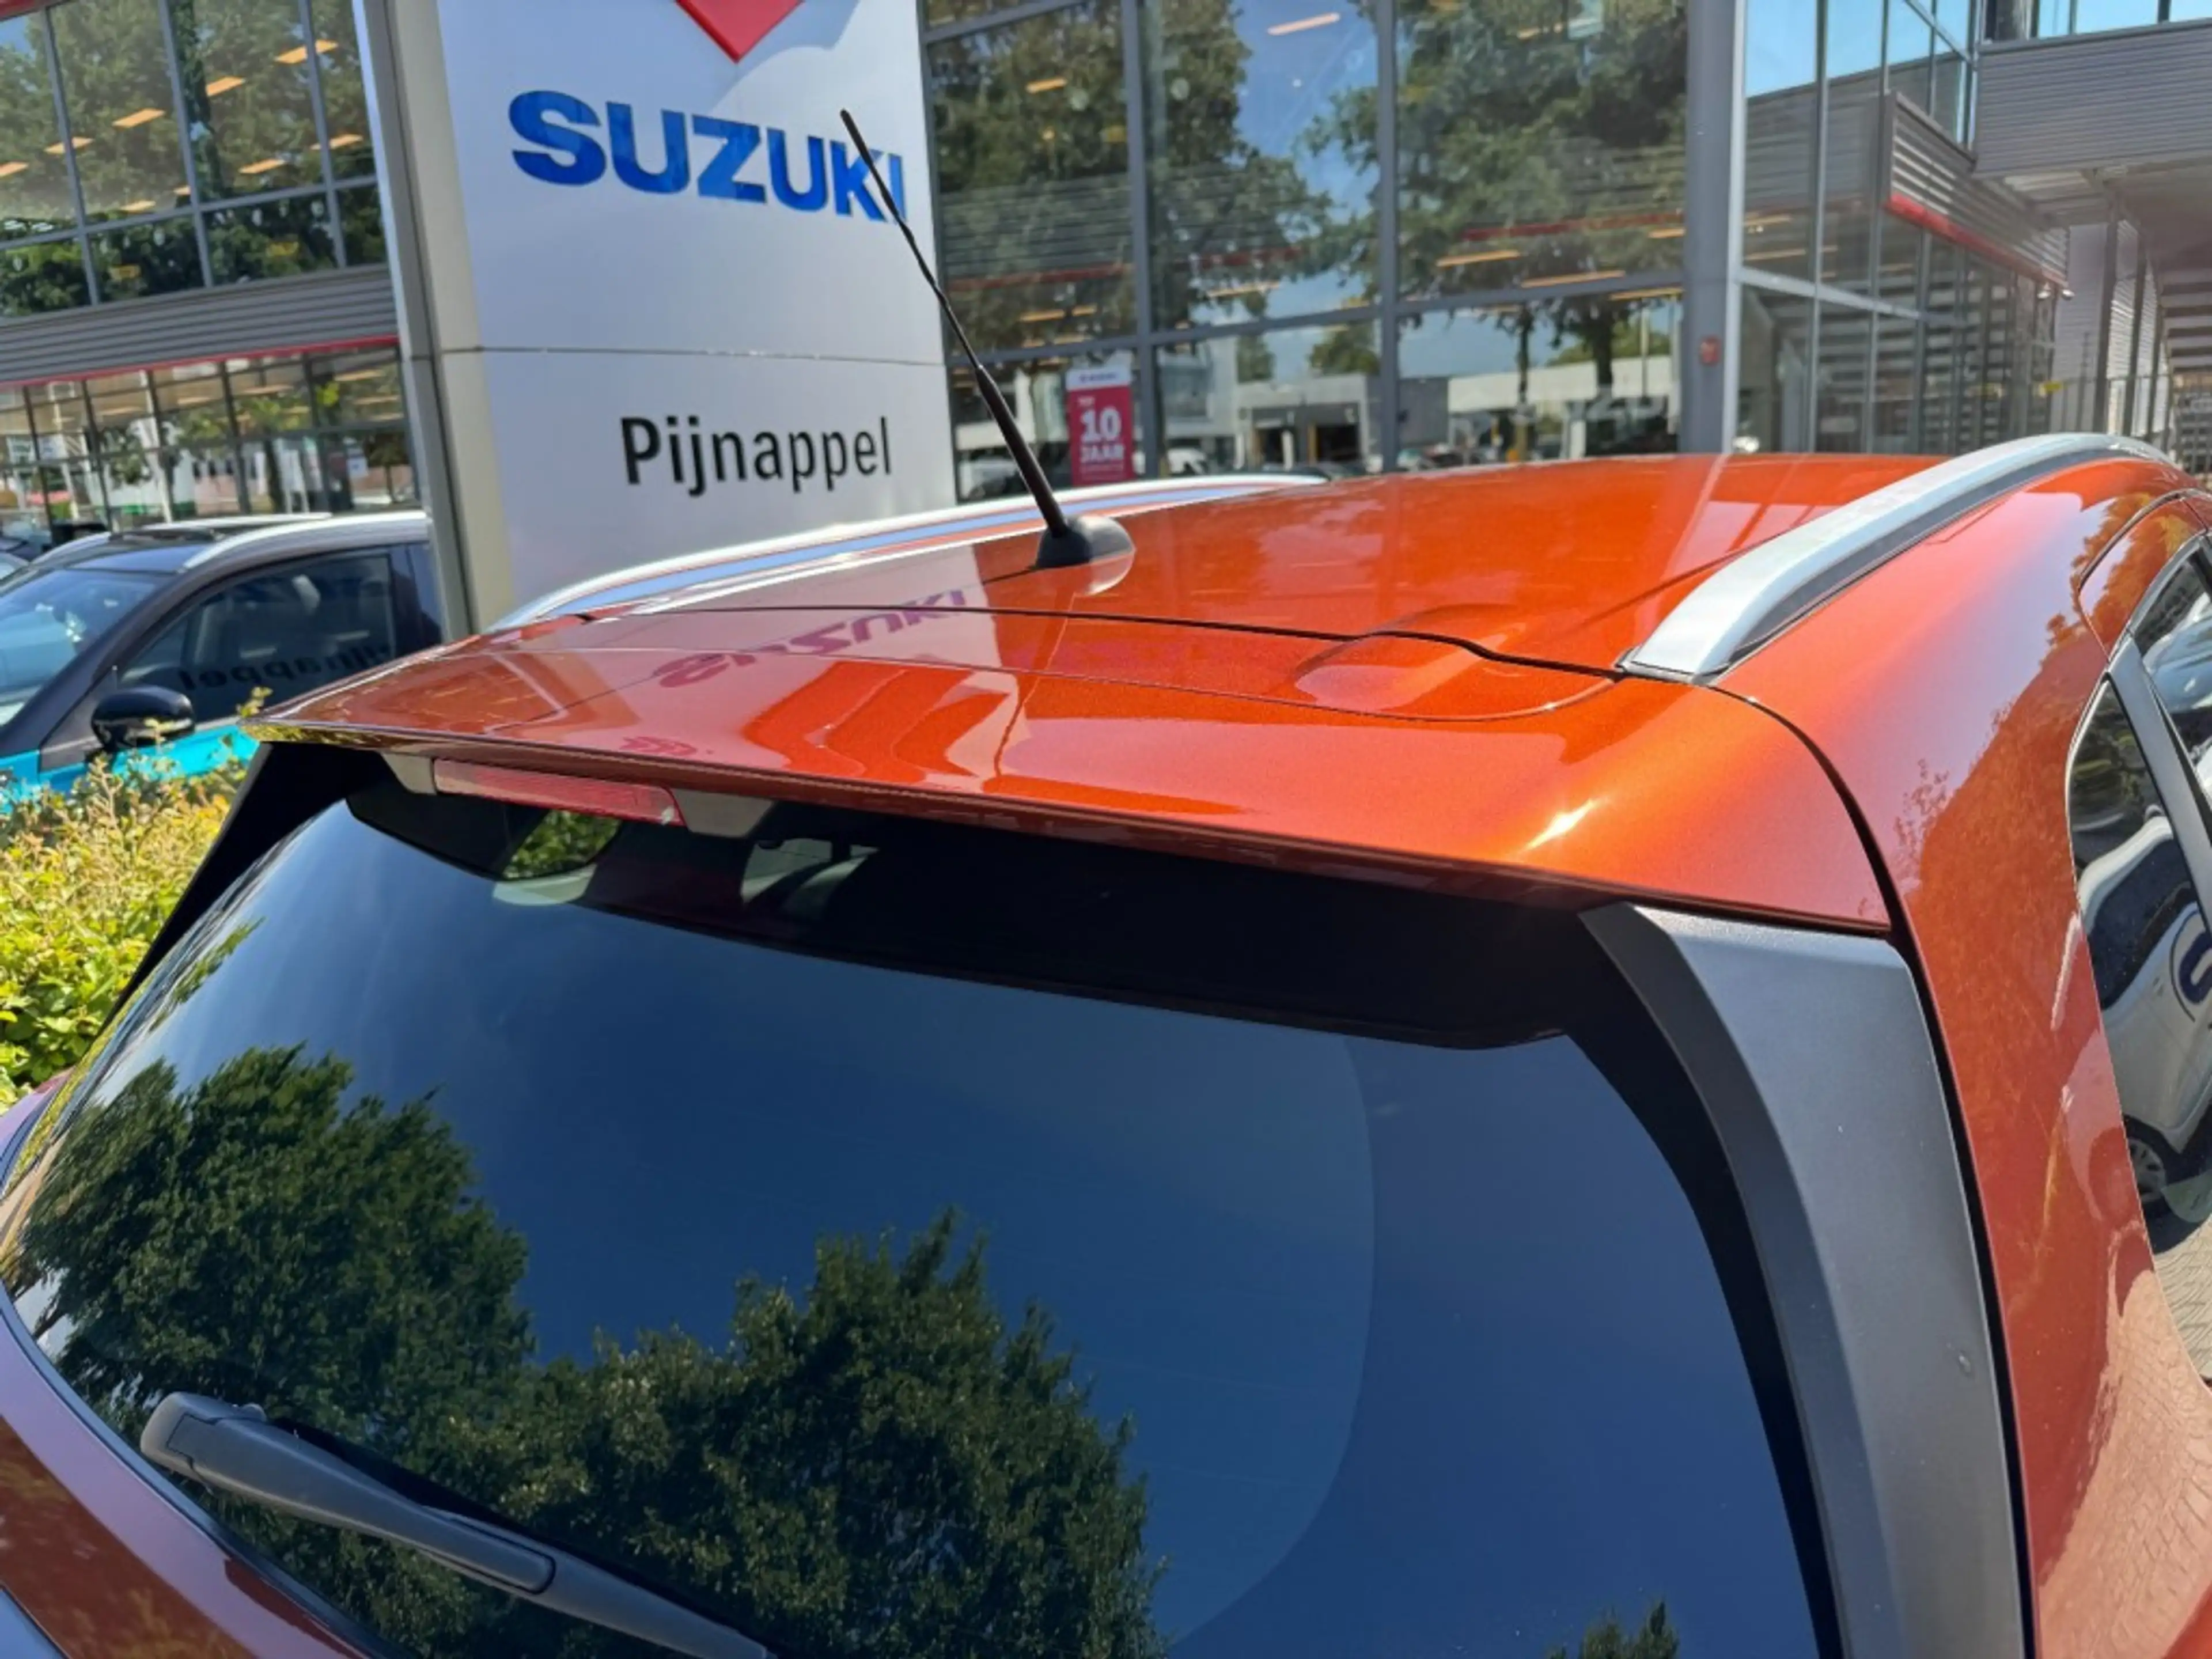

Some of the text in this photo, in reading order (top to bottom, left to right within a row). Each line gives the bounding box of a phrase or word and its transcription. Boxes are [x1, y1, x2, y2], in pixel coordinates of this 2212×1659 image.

[507, 90, 907, 223] SUZUKI
[621, 416, 892, 497] Pijnappel
[1081, 406, 1122, 443] 10
